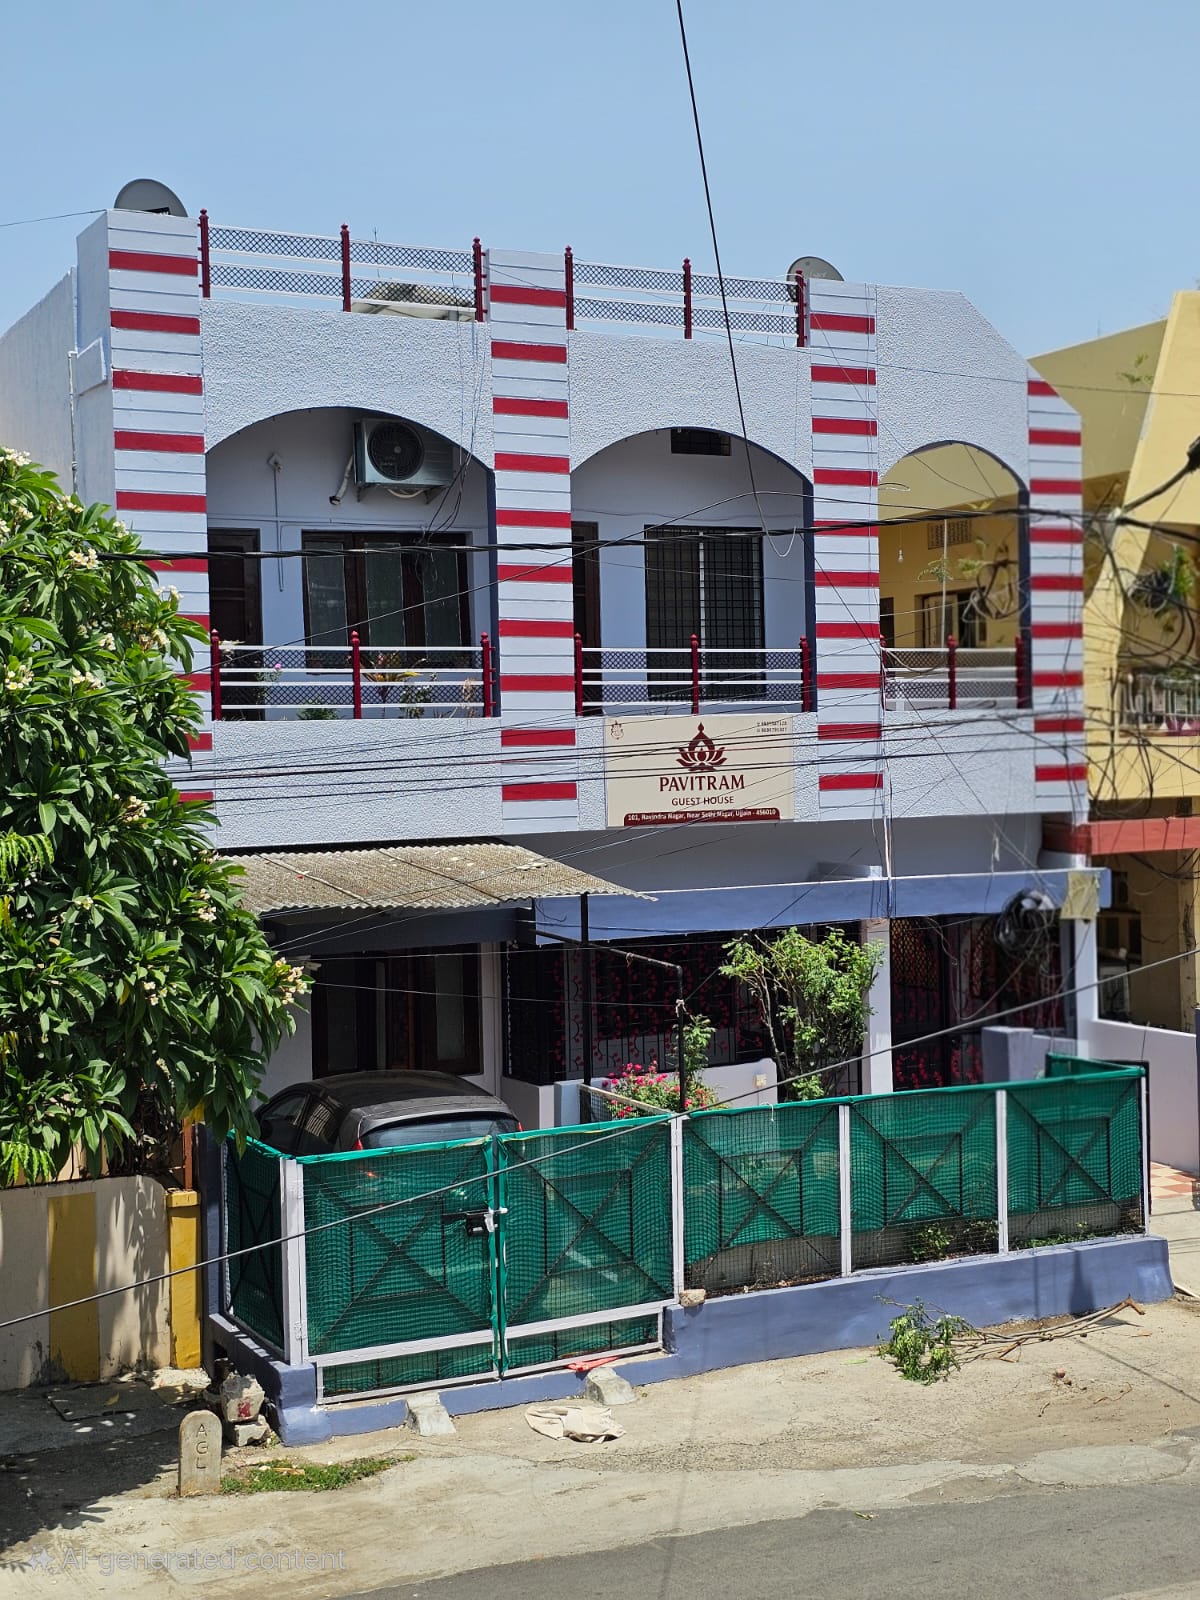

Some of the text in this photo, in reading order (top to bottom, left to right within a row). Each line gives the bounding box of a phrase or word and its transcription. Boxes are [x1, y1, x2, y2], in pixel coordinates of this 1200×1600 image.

[659, 774, 745, 792] PAVITRAM
[671, 796, 734, 806] GUEST HOUSE
